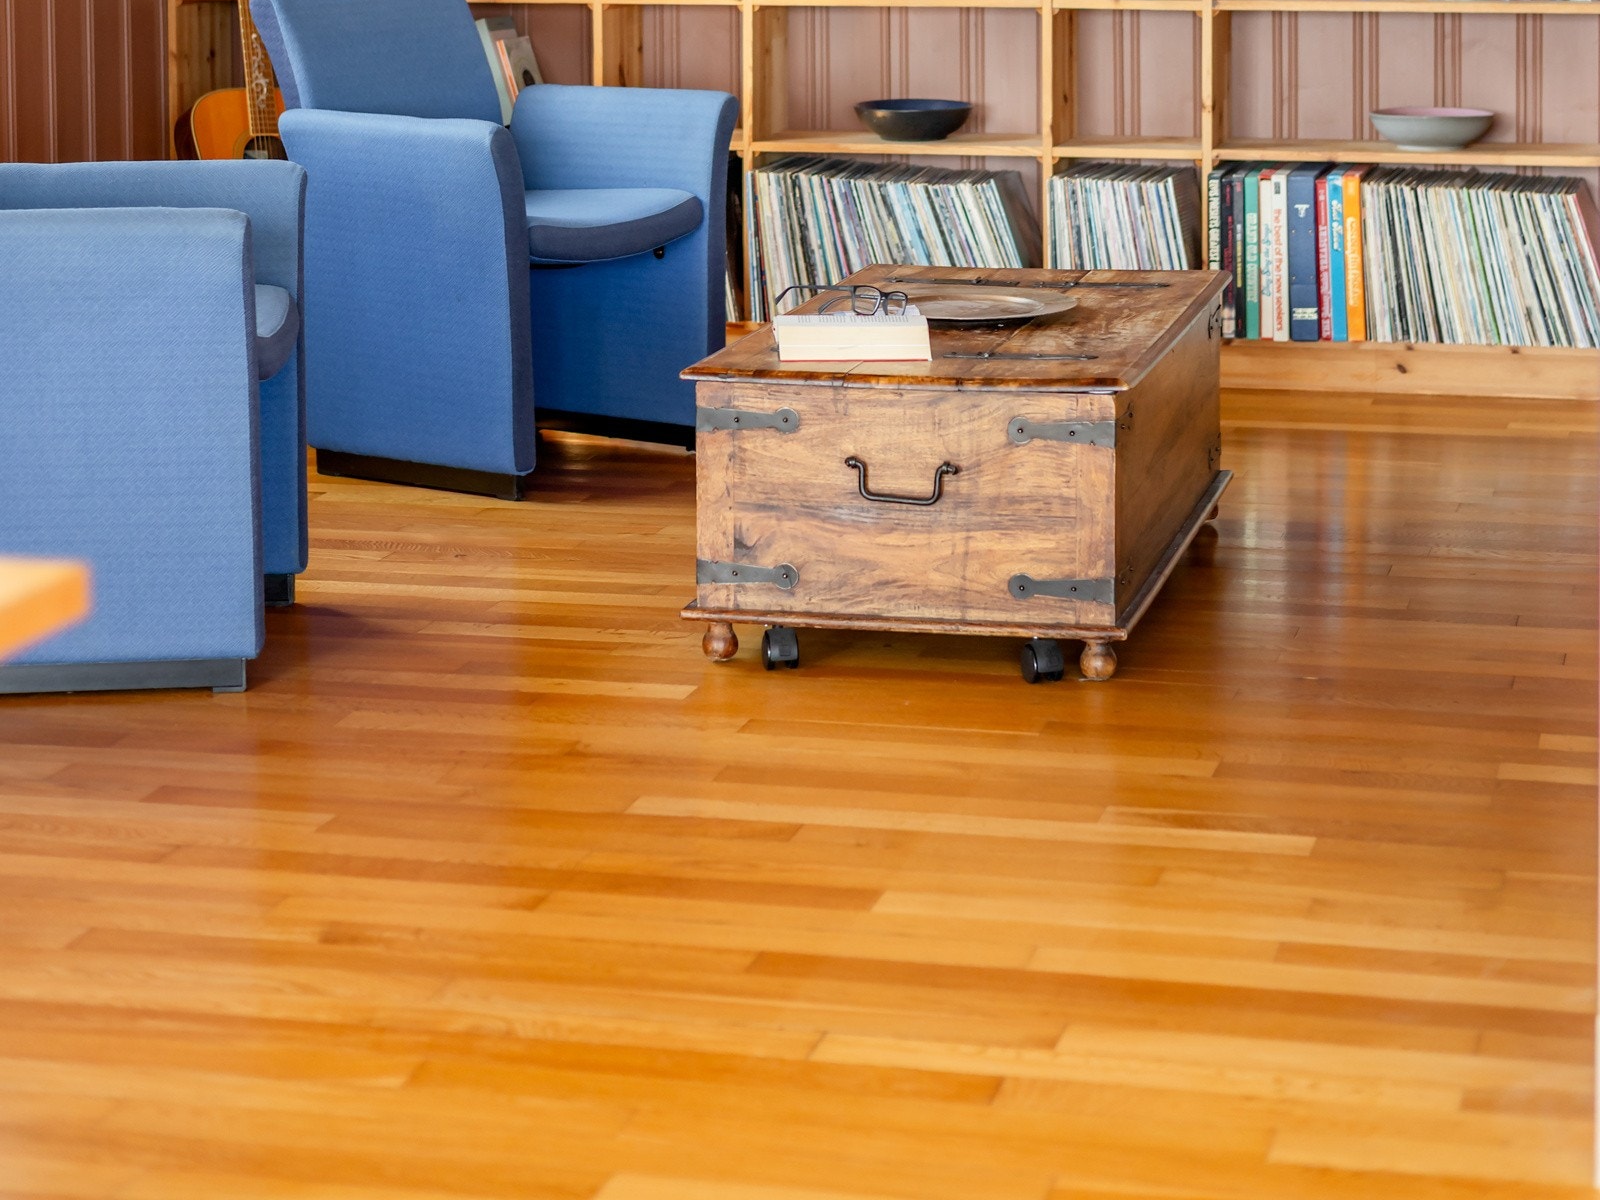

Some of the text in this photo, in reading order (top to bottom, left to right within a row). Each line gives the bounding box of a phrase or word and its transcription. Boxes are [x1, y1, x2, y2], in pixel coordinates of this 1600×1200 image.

[1274, 209, 1282, 224] the
[1274, 225, 1282, 247] best
[1275, 248, 1283, 256] of
[1275, 258, 1283, 272] the
[1275, 296, 1284, 332] seekers
